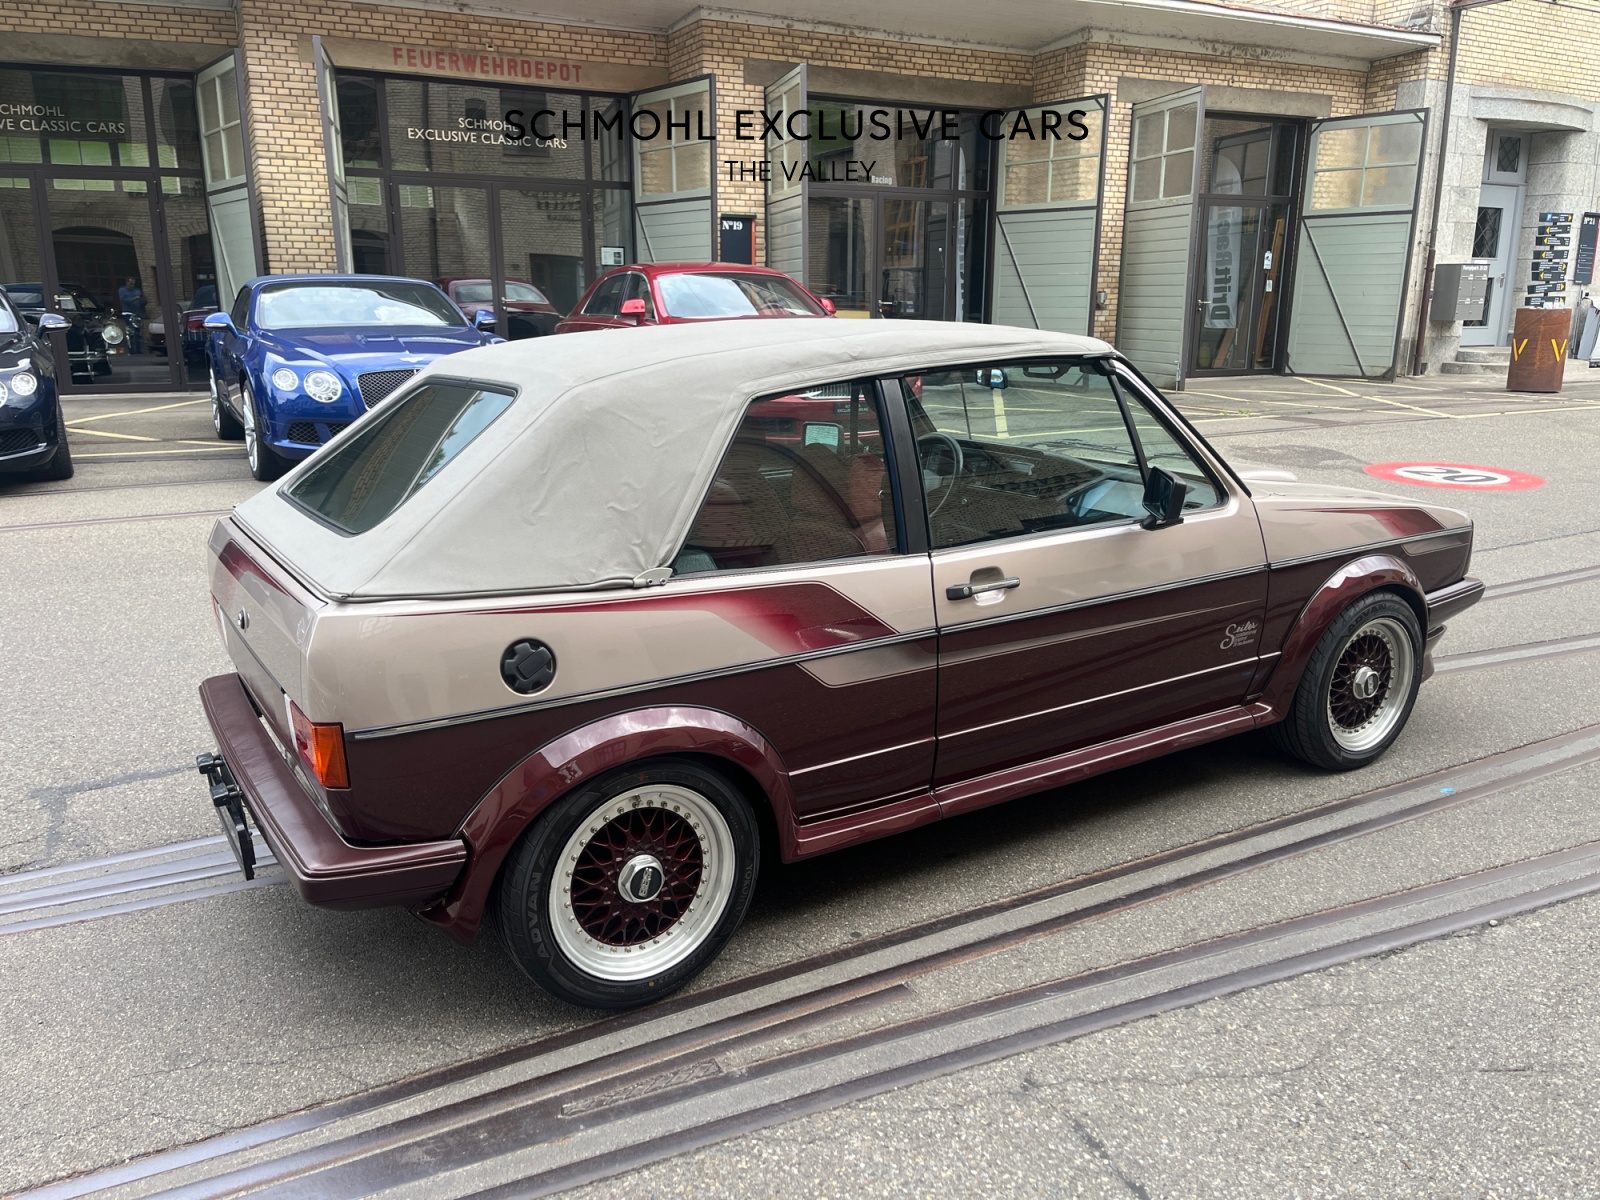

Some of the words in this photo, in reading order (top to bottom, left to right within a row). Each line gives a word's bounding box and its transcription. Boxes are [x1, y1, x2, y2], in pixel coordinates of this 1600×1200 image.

[393, 47, 582, 82] FEUERWEHRDEPOT
[20, 119, 82, 132] CLASSIC
[86, 122, 126, 134] CARS
[407, 128, 477, 144] EXCLUSIVE
[481, 132, 531, 147] CLASSIC
[535, 138, 568, 149] CARS
[1402, 467, 1498, 483] 20
[528, 872, 550, 958] ADVAN
